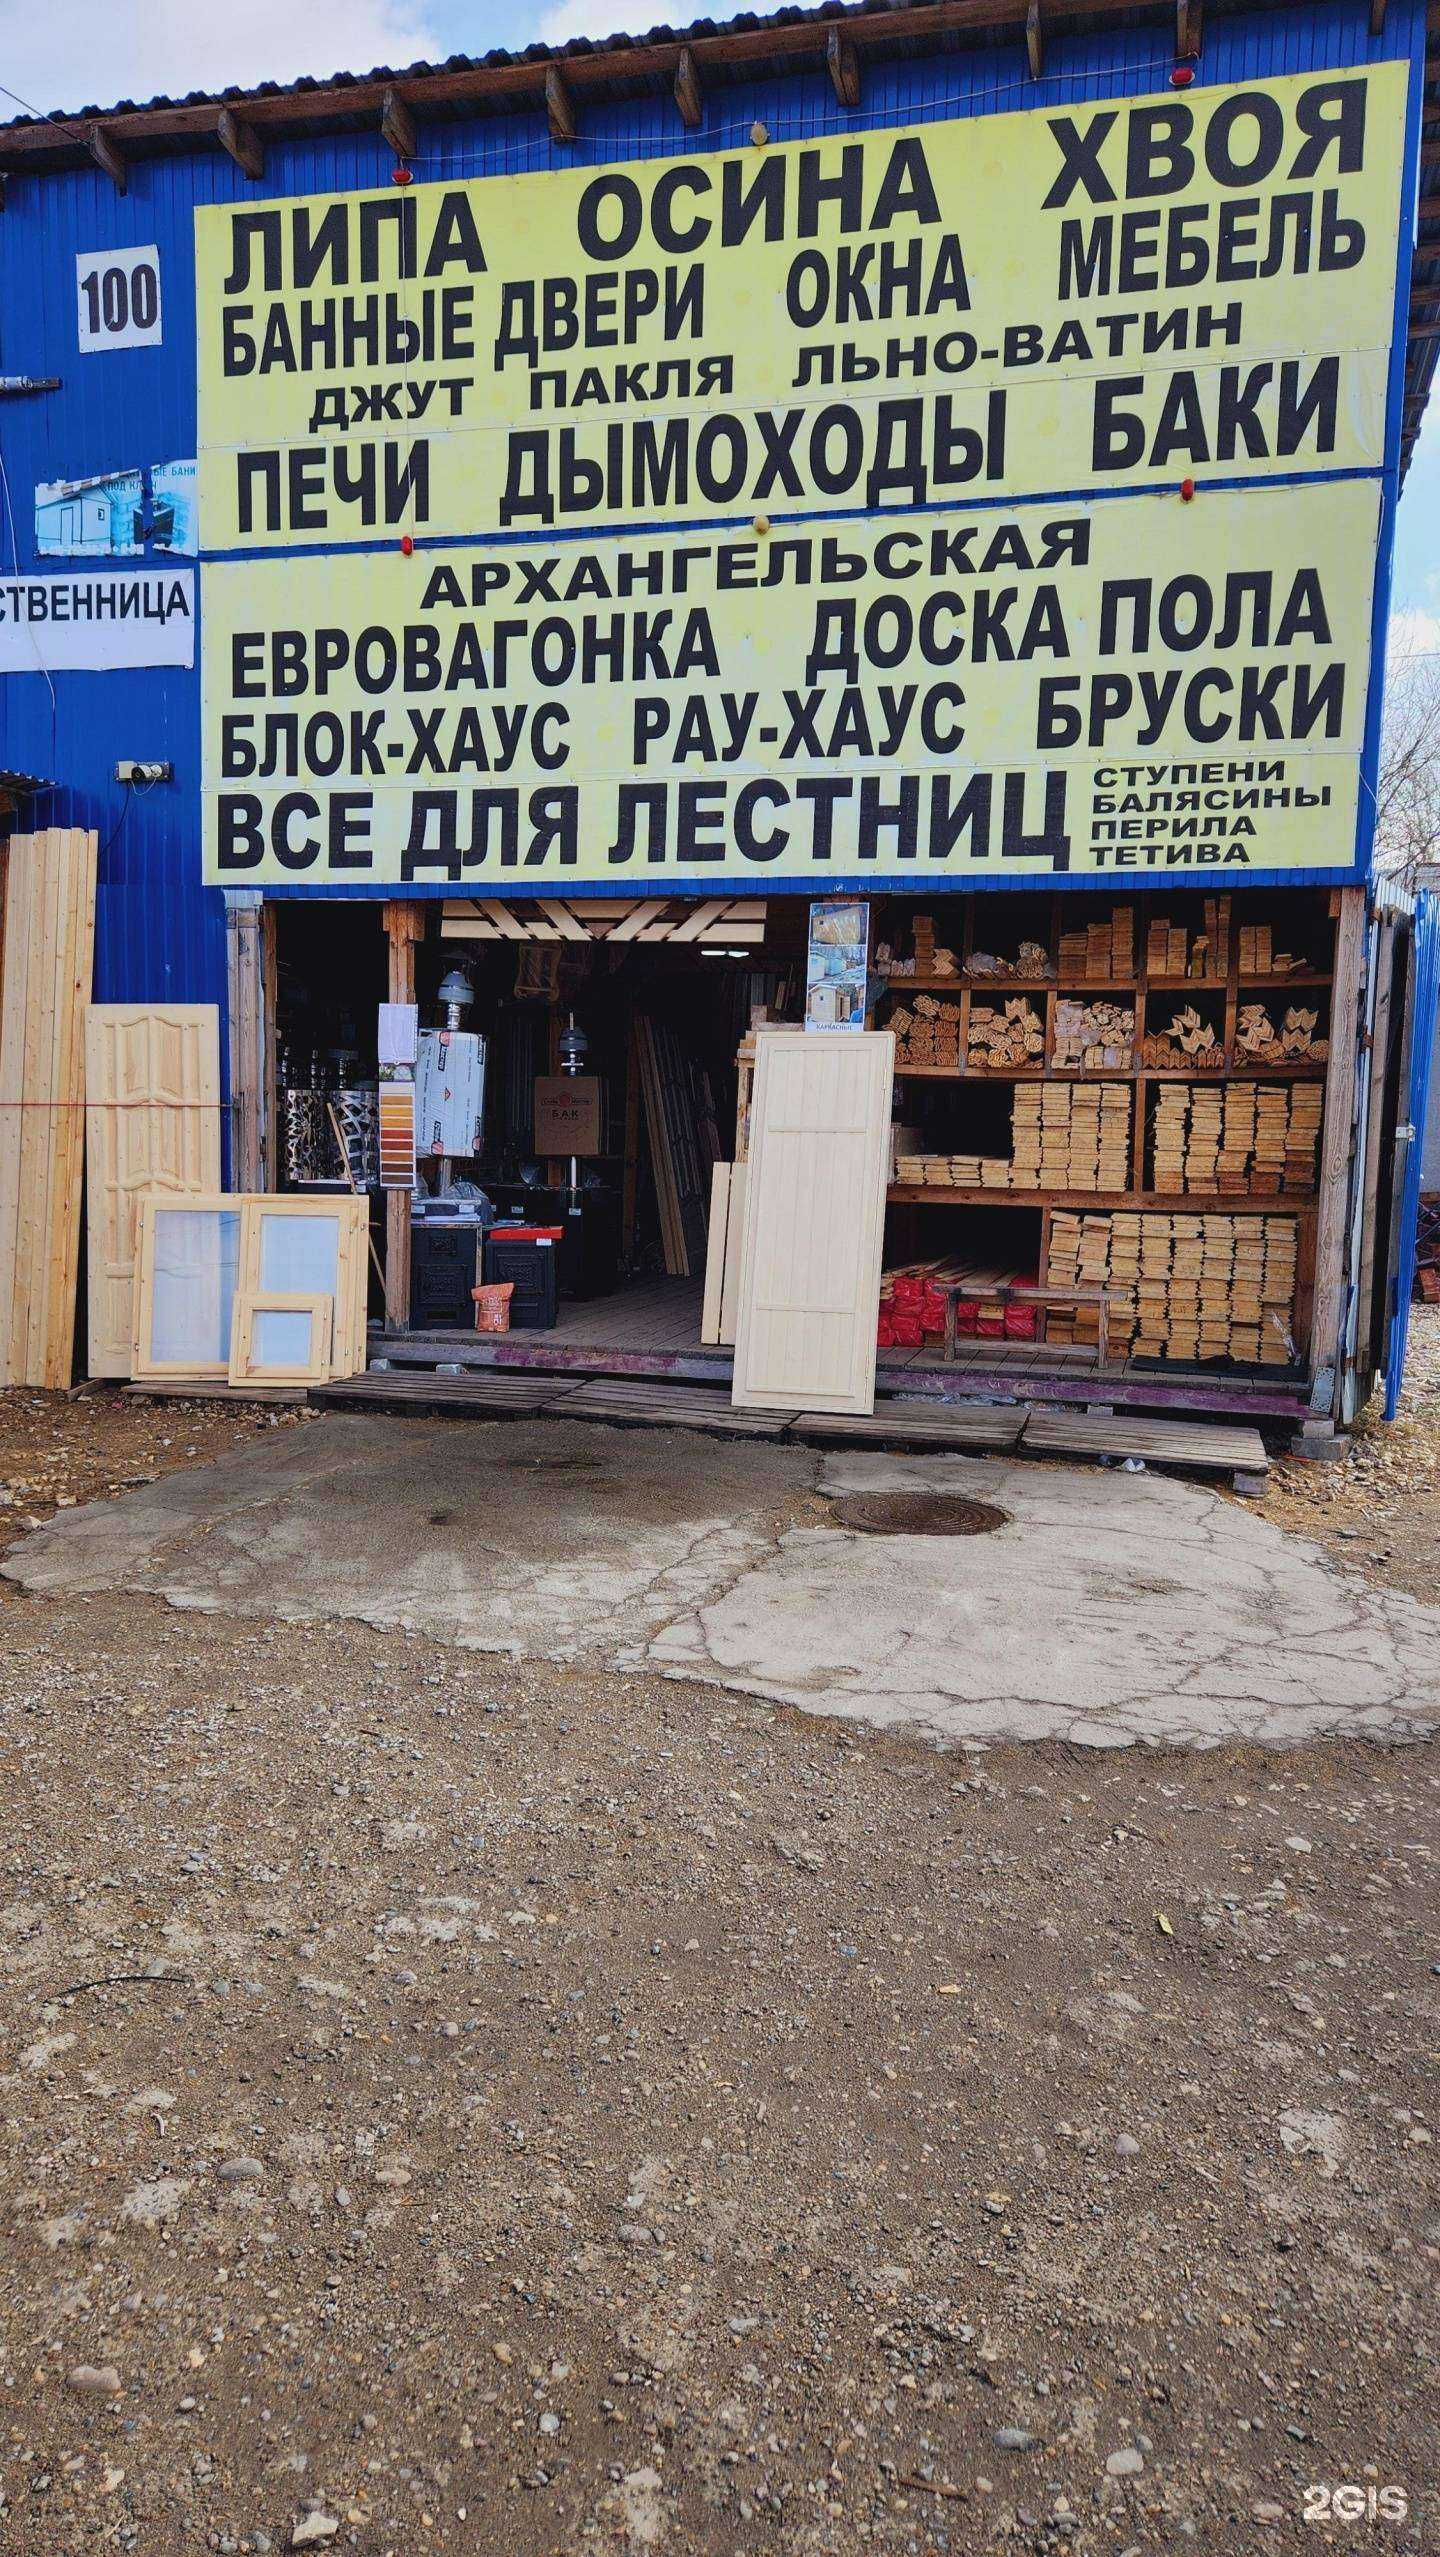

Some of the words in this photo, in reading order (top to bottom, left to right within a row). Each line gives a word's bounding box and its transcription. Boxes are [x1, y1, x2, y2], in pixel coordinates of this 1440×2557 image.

[224, 191, 487, 294] ЛИПА
[578, 137, 942, 261] ОСИНА
[1041, 78, 1367, 209] ХВОЯ
[81, 264, 158, 334] 100
[223, 286, 474, 376] БАННЫЕ
[495, 264, 704, 371] ДВЕРИ
[787, 234, 971, 328] ОКНА
[1059, 189, 1365, 300] МЕБЕЛЬ
[309, 378, 473, 433] ДЖУТ
[530, 355, 733, 409] ПАКЛЯ
[792, 302, 1242, 387] ЛЬНО-ВАТИН
[238, 440, 428, 532] ПЕЧИ
[500, 390, 1006, 526] ДЫМОХОДЫ
[1092, 357, 1339, 471] БАКИ
[0, 581, 190, 625] ТВЕННИЦА
[420, 519, 1090, 609] АРХАНГЕЛЬСКАЯ
[233, 607, 721, 698] ЕВРОВАГОНКА
[806, 585, 1070, 686] ДОСКА
[1099, 568, 1332, 655] ПОЛА
[222, 702, 570, 778] БЛОК-ХАУС
[634, 682, 965, 765] РАУ-ХАУС
[1037, 663, 1345, 749] БРУСКИ
[1093, 786, 1331, 814] БАЛЯСИНЫ
[1094, 761, 1284, 787] СТУПЕНИ
[218, 791, 373, 869] ВСЕ
[401, 786, 578, 881] ДЛЯ
[608, 771, 1070, 871] ЛЕСТНИЦ
[1089, 843, 1250, 866] ТЕТИВА
[1092, 816, 1257, 840] ПЕРИЛА
